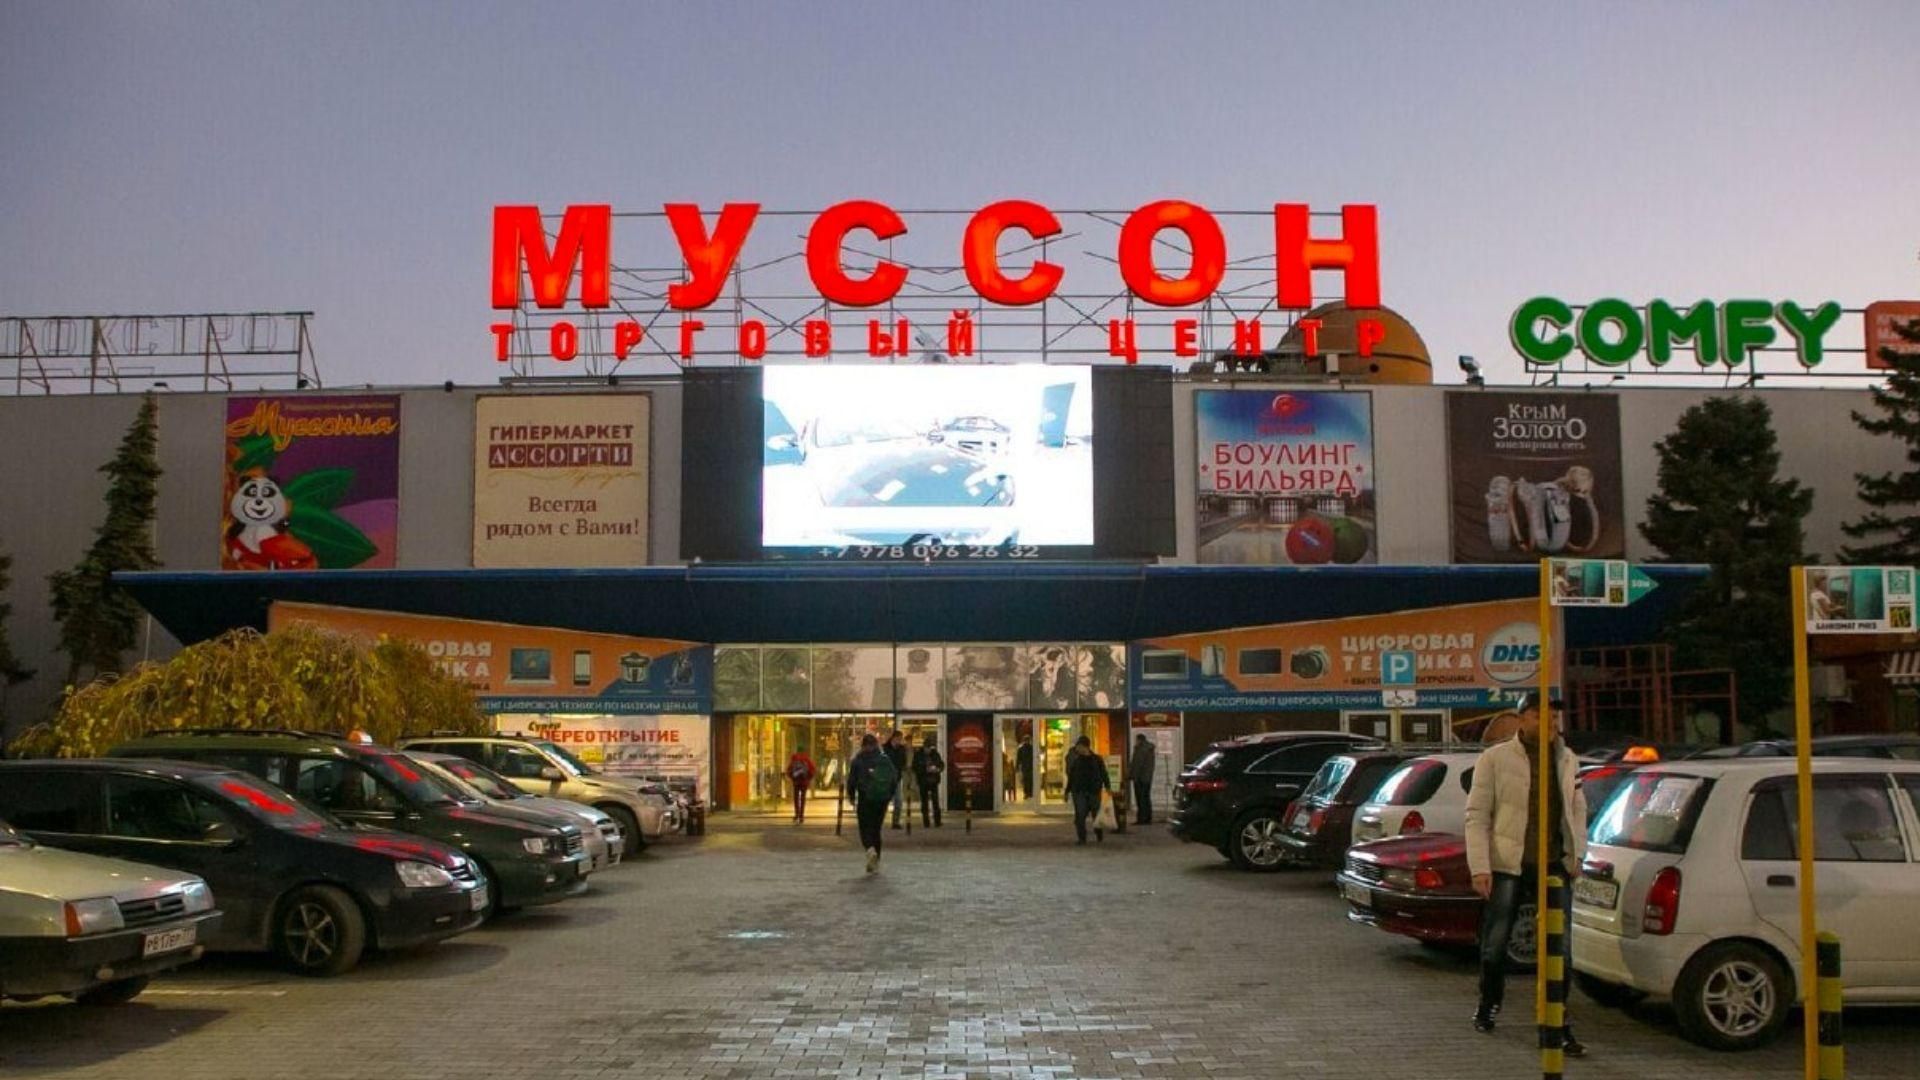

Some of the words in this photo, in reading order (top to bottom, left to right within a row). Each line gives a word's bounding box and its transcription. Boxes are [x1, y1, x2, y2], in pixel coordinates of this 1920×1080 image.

[493, 201, 1379, 307] МУССОН
[491, 310, 974, 361] ТОРГОВЫЙ
[1110, 318, 1387, 364] ЦЕНТР
[1510, 296, 1842, 367] COMFY
[489, 425, 634, 441] ГИПЕРМАРКЕТ
[490, 445, 632, 466] АССОРТИ
[1214, 443, 1356, 465] БОУЛИНГ
[1215, 469, 1357, 495] БИЛЬЯРД
[528, 496, 597, 513] Всегда
[486, 523, 552, 540] рядом
[559, 524, 569, 535] с
[576, 519, 639, 535] Вами!
[859, 545, 904, 558] 978
[912, 545, 959, 558] 096
[968, 545, 999, 558] 26
[1008, 545, 1039, 558] 32
[1341, 633, 1475, 654] ЦИФРОВАЯ
[1491, 644, 1541, 662] DNS
[1344, 654, 1474, 671] ТЕИКА
[1390, 654, 1409, 682] P
[1488, 688, 1500, 702] 2
